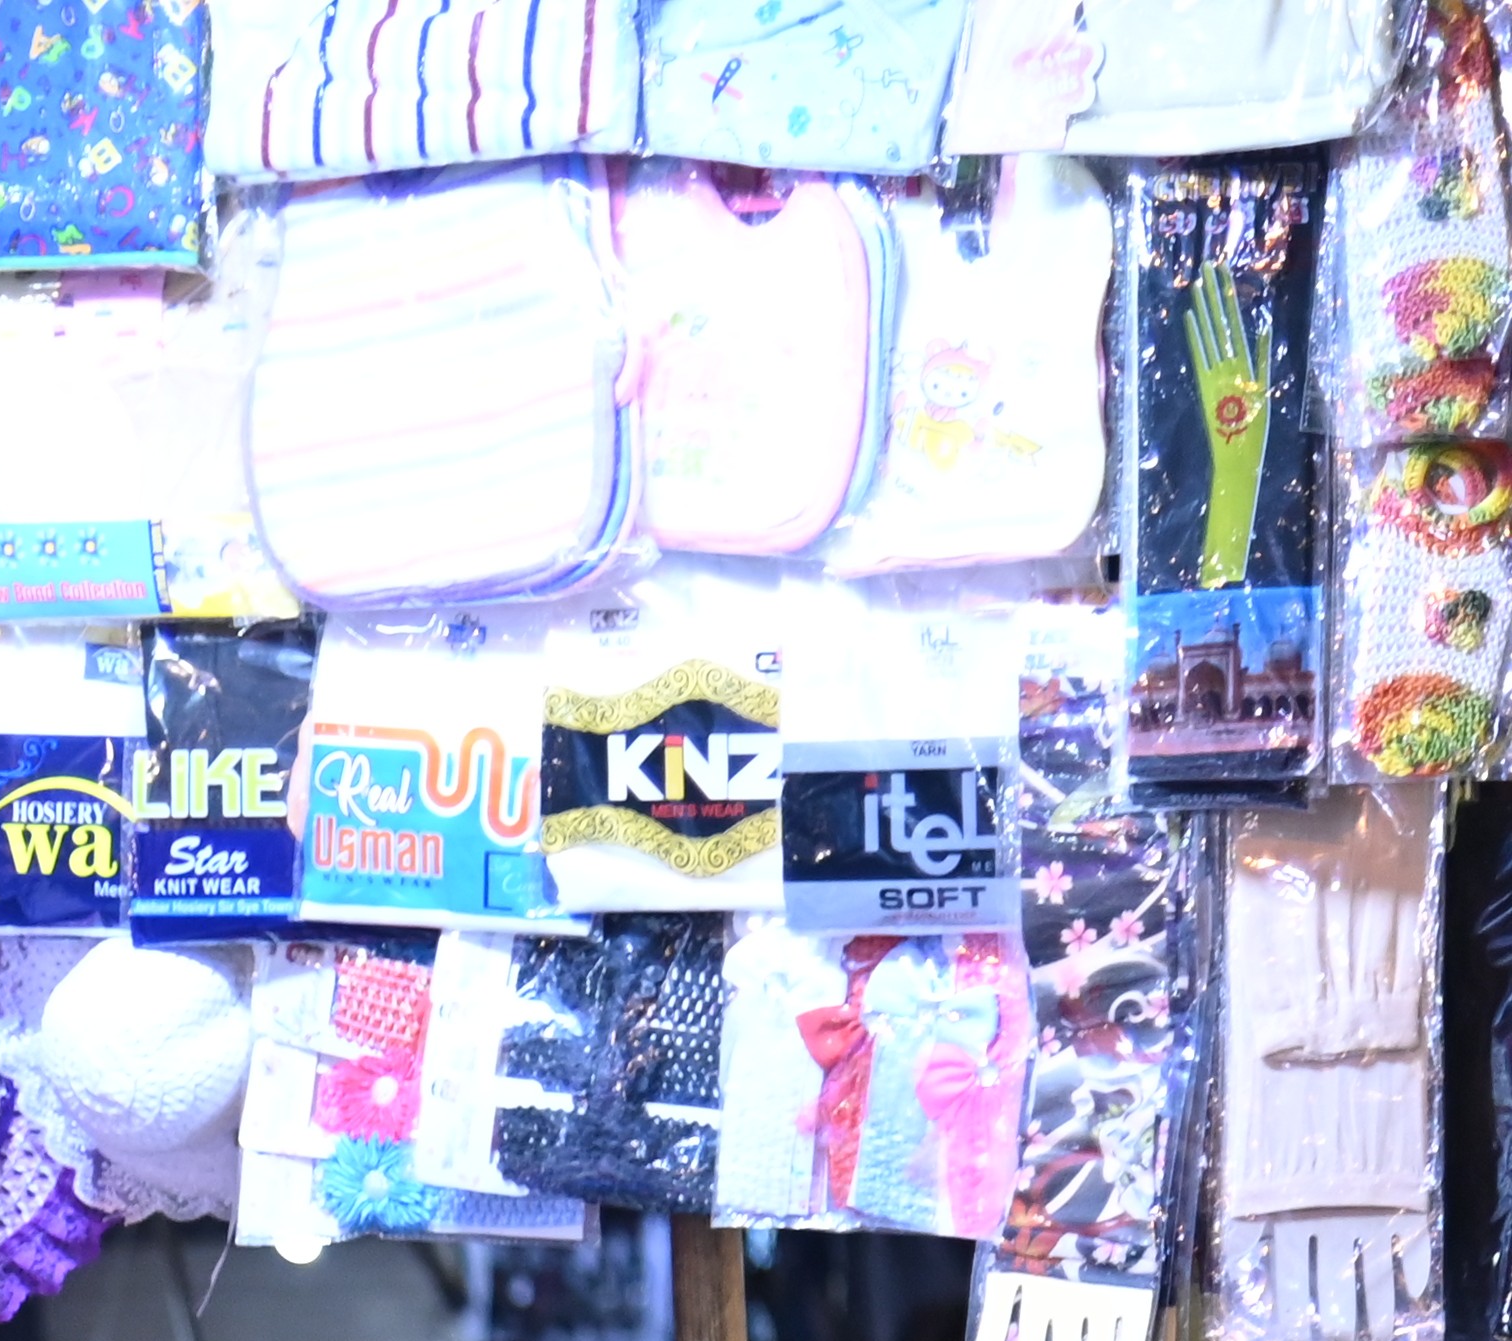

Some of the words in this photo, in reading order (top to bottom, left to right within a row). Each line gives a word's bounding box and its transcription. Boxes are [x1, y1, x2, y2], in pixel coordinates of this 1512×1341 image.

[60, 578, 149, 601] Collection
[911, 745, 947, 758] YARN
[314, 750, 414, 826] Real
[12, 799, 109, 824] HOSIERY
[650, 802, 698, 818] MEN'S
[700, 801, 745, 818] WEAR
[164, 834, 250, 876] Star
[313, 814, 444, 879] Usman
[153, 877, 197, 896] KNIT
[202, 876, 261, 896] WEAR
[879, 886, 987, 909] SOFT
